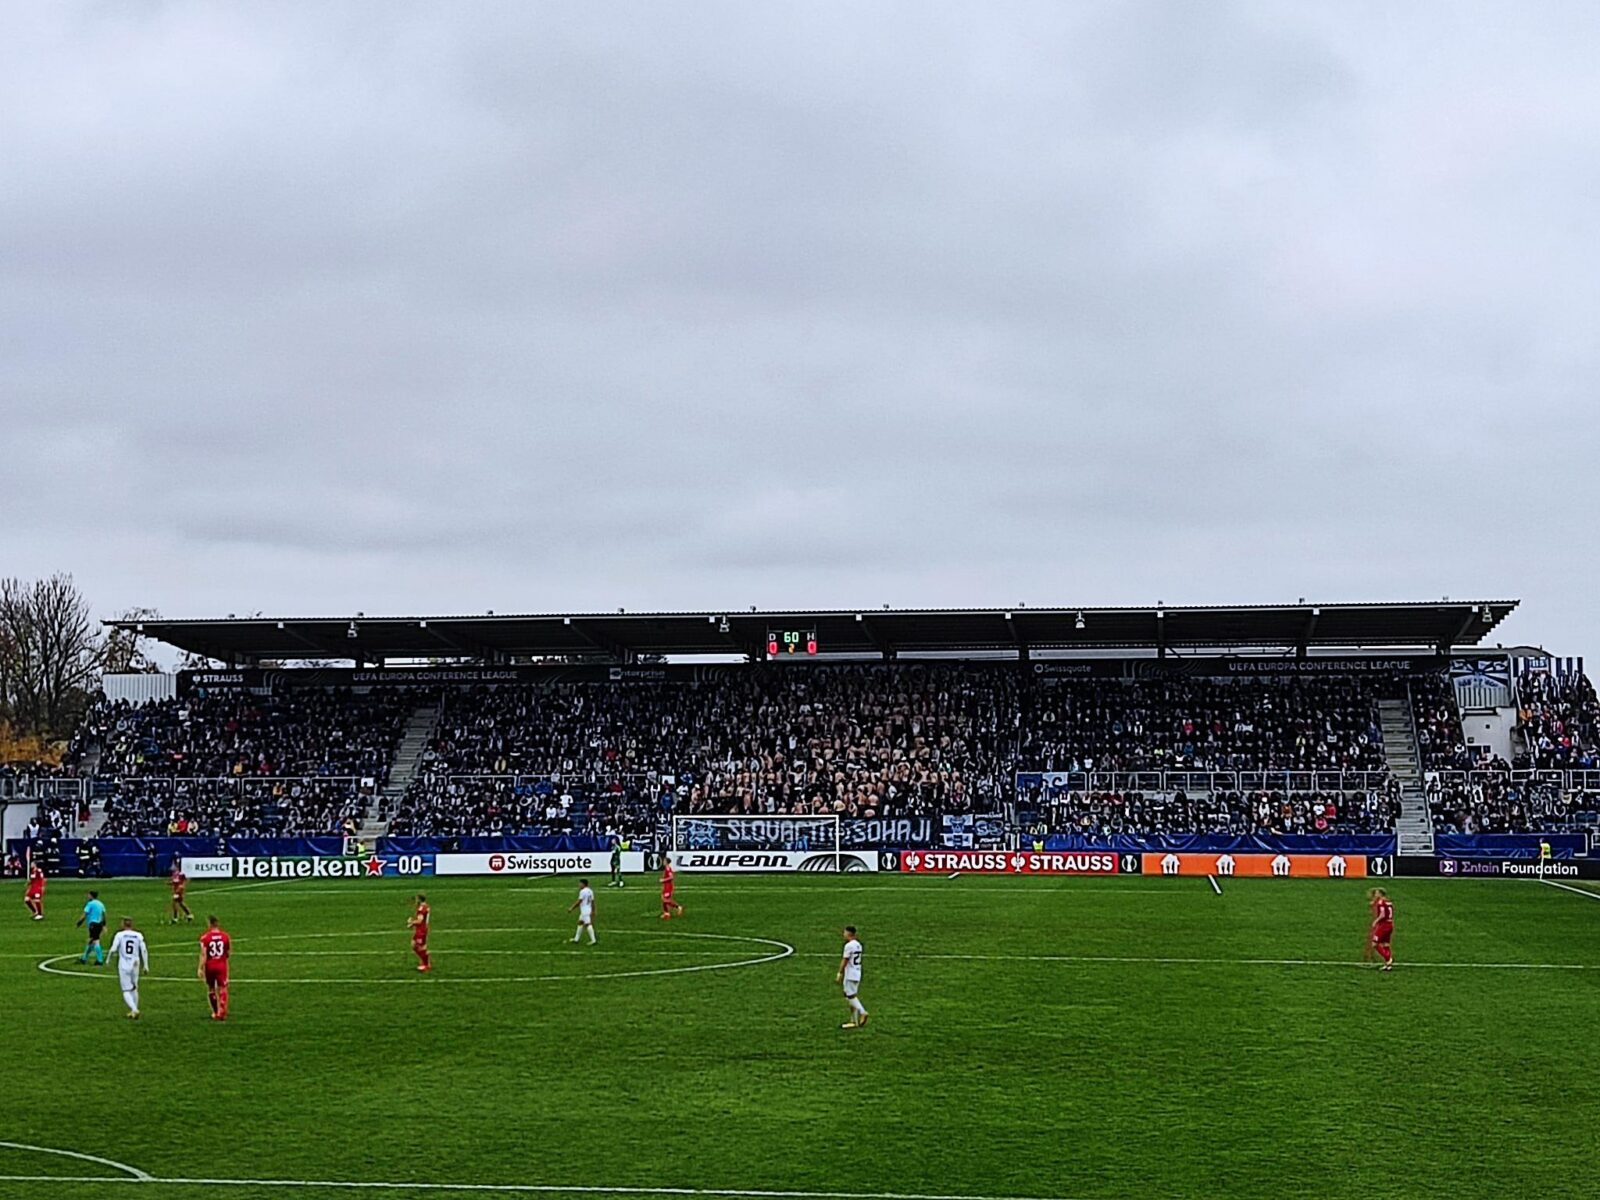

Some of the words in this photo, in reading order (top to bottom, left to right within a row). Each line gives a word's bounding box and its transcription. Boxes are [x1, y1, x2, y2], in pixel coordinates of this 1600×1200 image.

[784, 631, 799, 643] 60
[769, 641, 778, 654] 0
[807, 641, 817, 654] 0
[1044, 664, 1091, 674] Swissquote
[1229, 662, 1256, 671] UEFA
[1258, 662, 1297, 671] EUROPA
[1299, 661, 1367, 670] CONFERENCE
[202, 674, 244, 683] STRAUSS
[352, 672, 377, 681] UEFA
[379, 672, 415, 681] EUROPA
[416, 671, 479, 680] CONFERENCE
[481, 671, 518, 680] LEAGUE
[194, 863, 230, 872] RESPECT
[236, 857, 360, 877] Heineken
[507, 855, 592, 873] Swissquote
[924, 854, 1007, 869] STRAUSS
[1029, 855, 1113, 871] STRAUSS
[1502, 861, 1579, 876] Foundation
[125, 940, 134, 955] 6
[208, 940, 225, 957] 33
